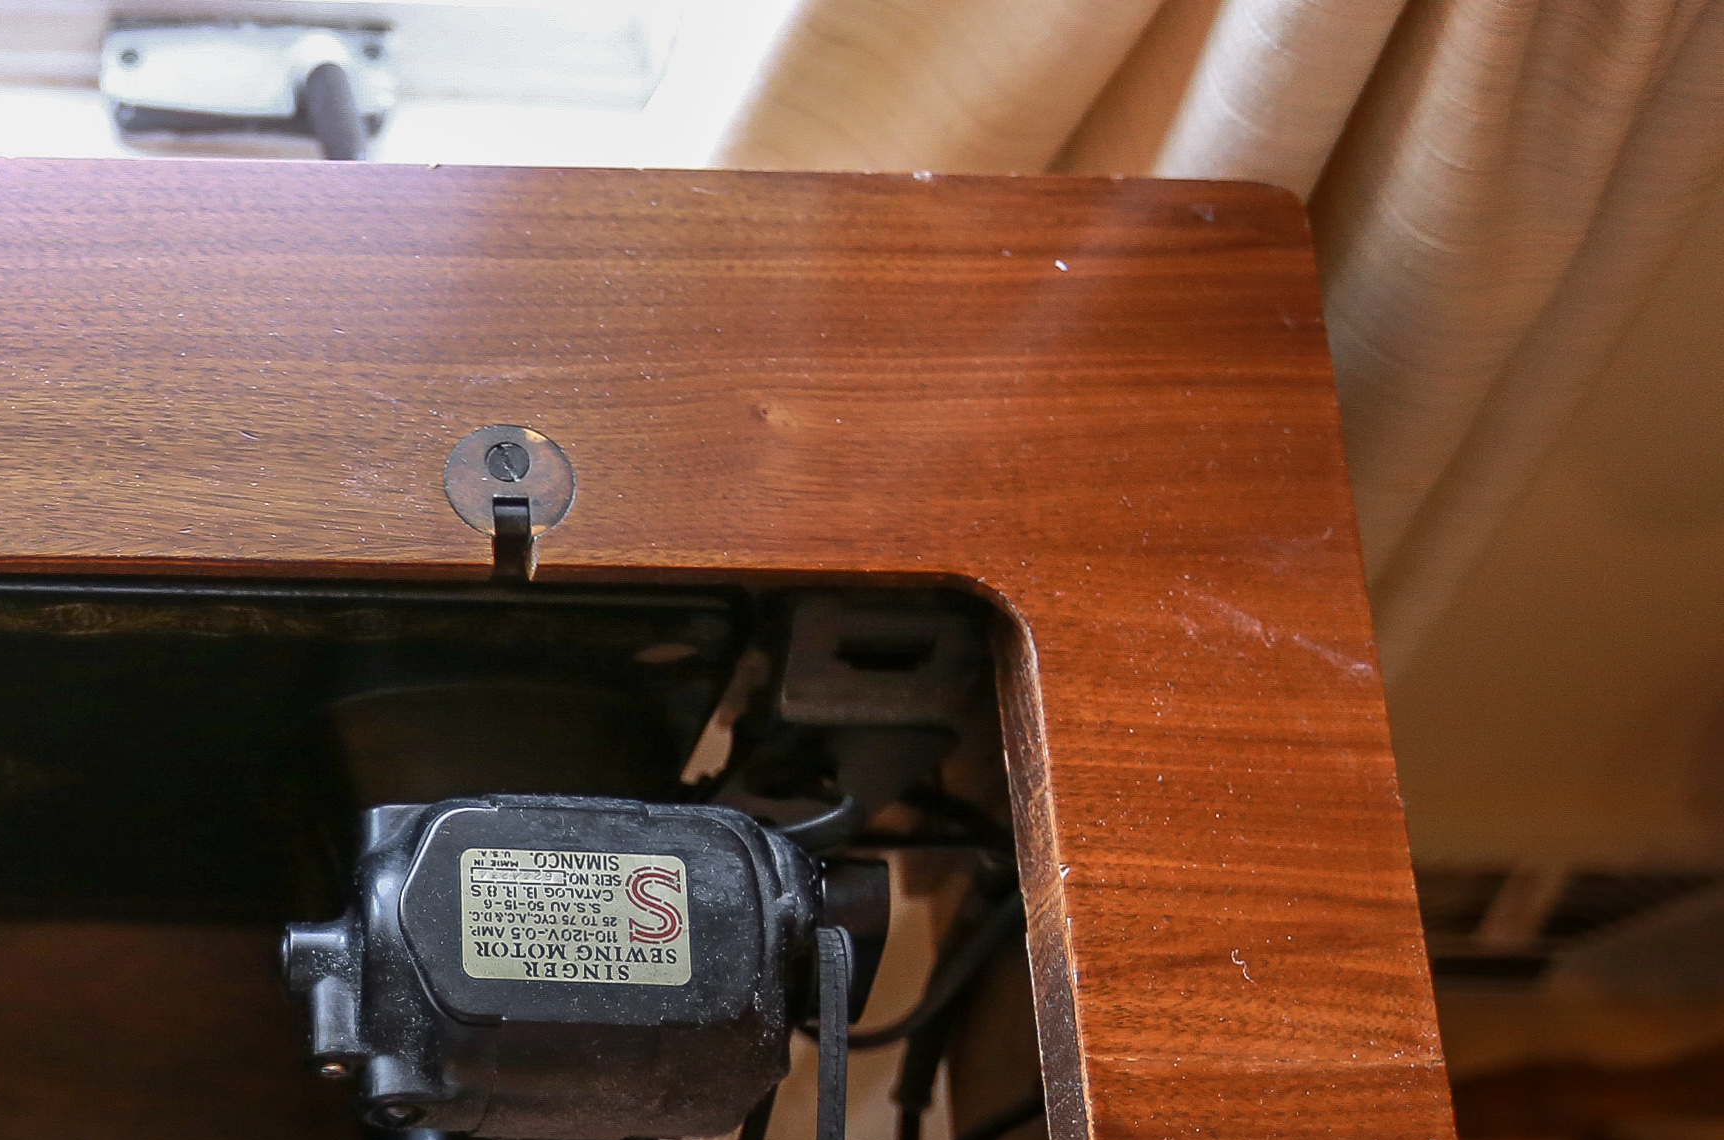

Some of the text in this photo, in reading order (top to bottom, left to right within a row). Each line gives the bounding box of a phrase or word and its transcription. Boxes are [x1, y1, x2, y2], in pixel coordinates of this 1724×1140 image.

[490, 860, 519, 868] MADE
[544, 887, 614, 902] CATALOG
[625, 866, 682, 944] S
[562, 914, 576, 925] 75
[582, 915, 597, 926] TO
[603, 916, 617, 927] 25
[469, 925, 505, 938] AMP.
[474, 941, 677, 964] SEWING MOTOR
[523, 962, 629, 980] SINGER
